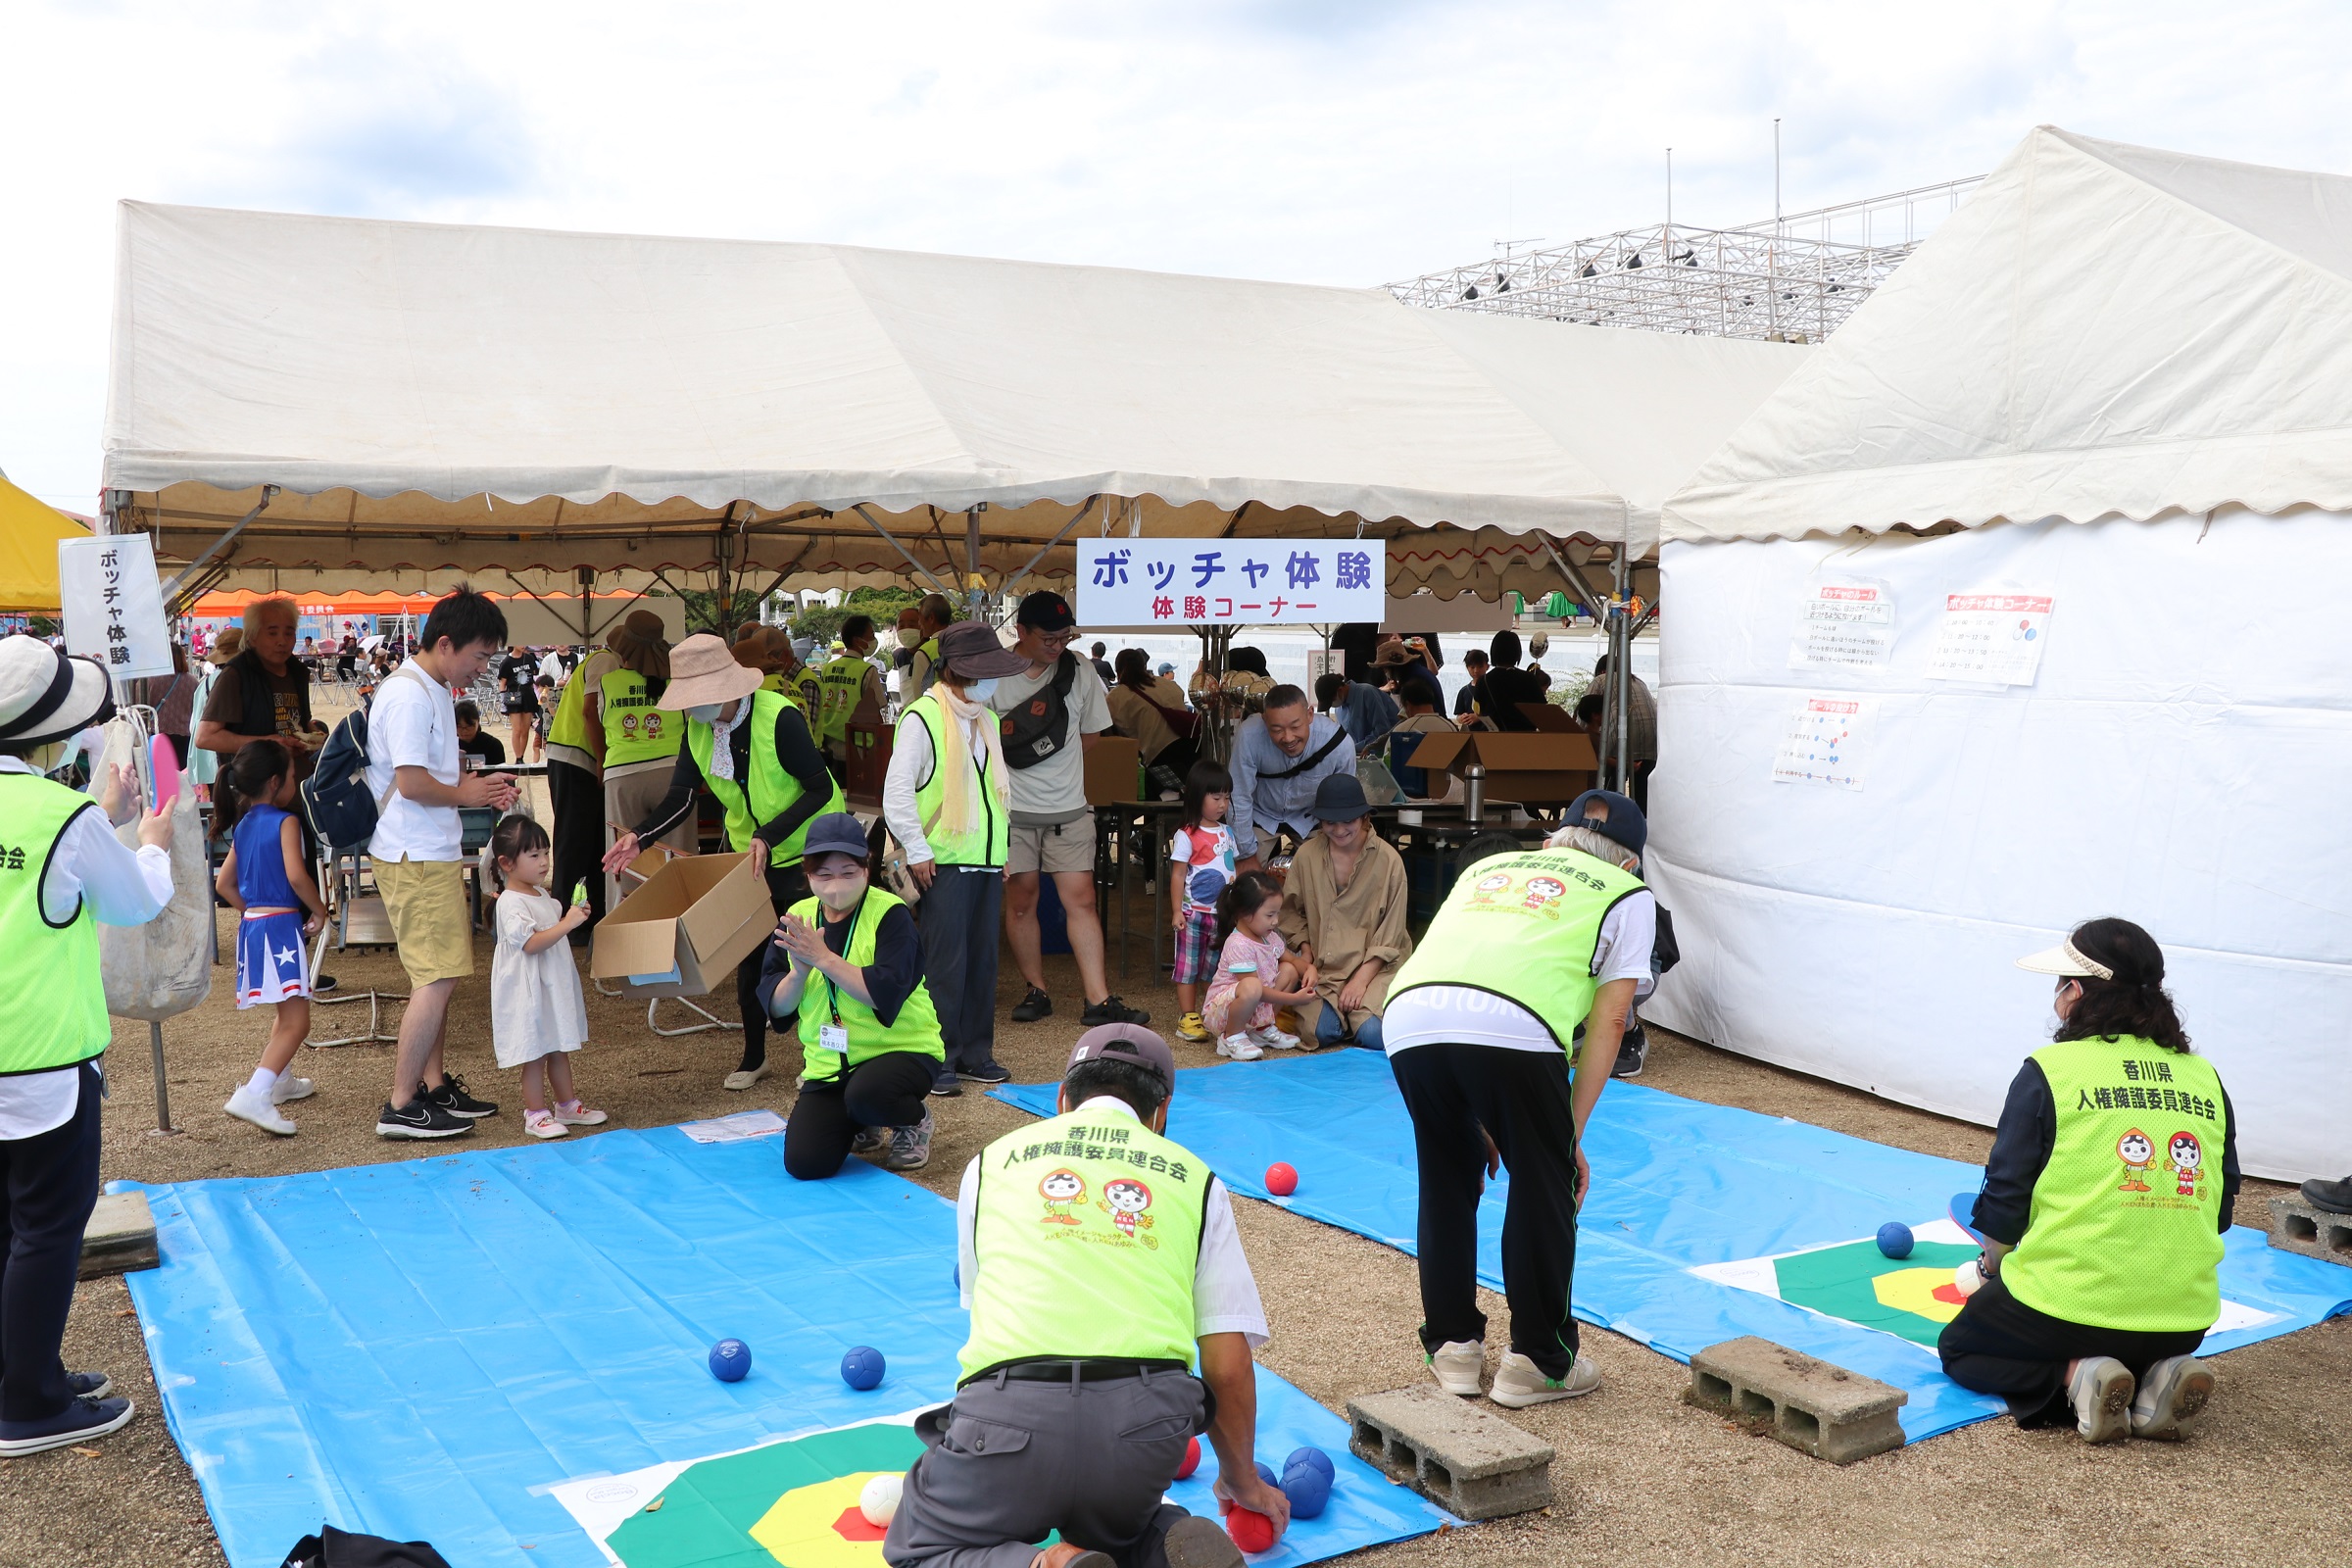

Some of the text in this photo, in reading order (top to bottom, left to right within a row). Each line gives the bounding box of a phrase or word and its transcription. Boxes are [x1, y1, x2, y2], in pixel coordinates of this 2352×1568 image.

[1093, 549, 1371, 590] ボッチャ体験
[1821, 588, 1876, 599] ボッチャのルール
[1948, 596, 2047, 611] ボッチャ体験コーナー
[101, 549, 130, 665] ボッチャ体験
[1152, 596, 1316, 619] 体験コーナー
[629, 685, 646, 695] 香川
[1810, 701, 1857, 713] ボールの投げ方
[2123, 1059, 2174, 1083] 香川県
[2078, 1087, 2216, 1121] 人権擁護委員連合会
[1067, 1126, 1130, 1145] 香川県
[1004, 1141, 1189, 1184] 人権擁護委員連合会
